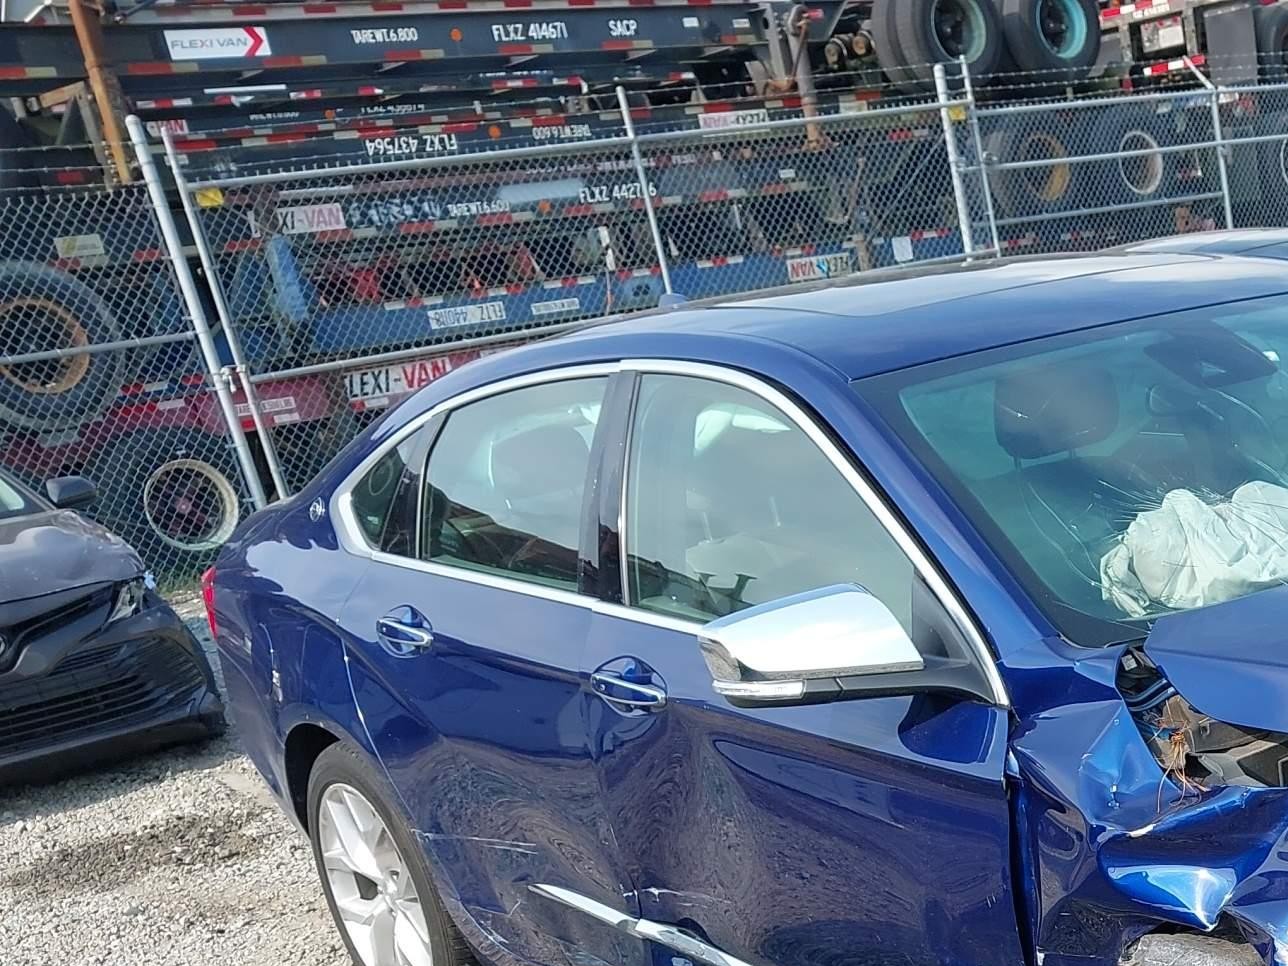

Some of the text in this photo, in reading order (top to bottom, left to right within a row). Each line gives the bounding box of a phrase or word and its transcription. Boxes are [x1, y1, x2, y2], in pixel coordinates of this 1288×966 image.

[492, 22, 569, 41] FLXZ 414671
[608, 19, 637, 36] SACP
[170, 37, 248, 50] FLEXI VAN
[365, 133, 458, 156] FLXZ 437564
[579, 182, 657, 204] FLXZ 44276
[347, 358, 447, 398] LEXI-VAN
